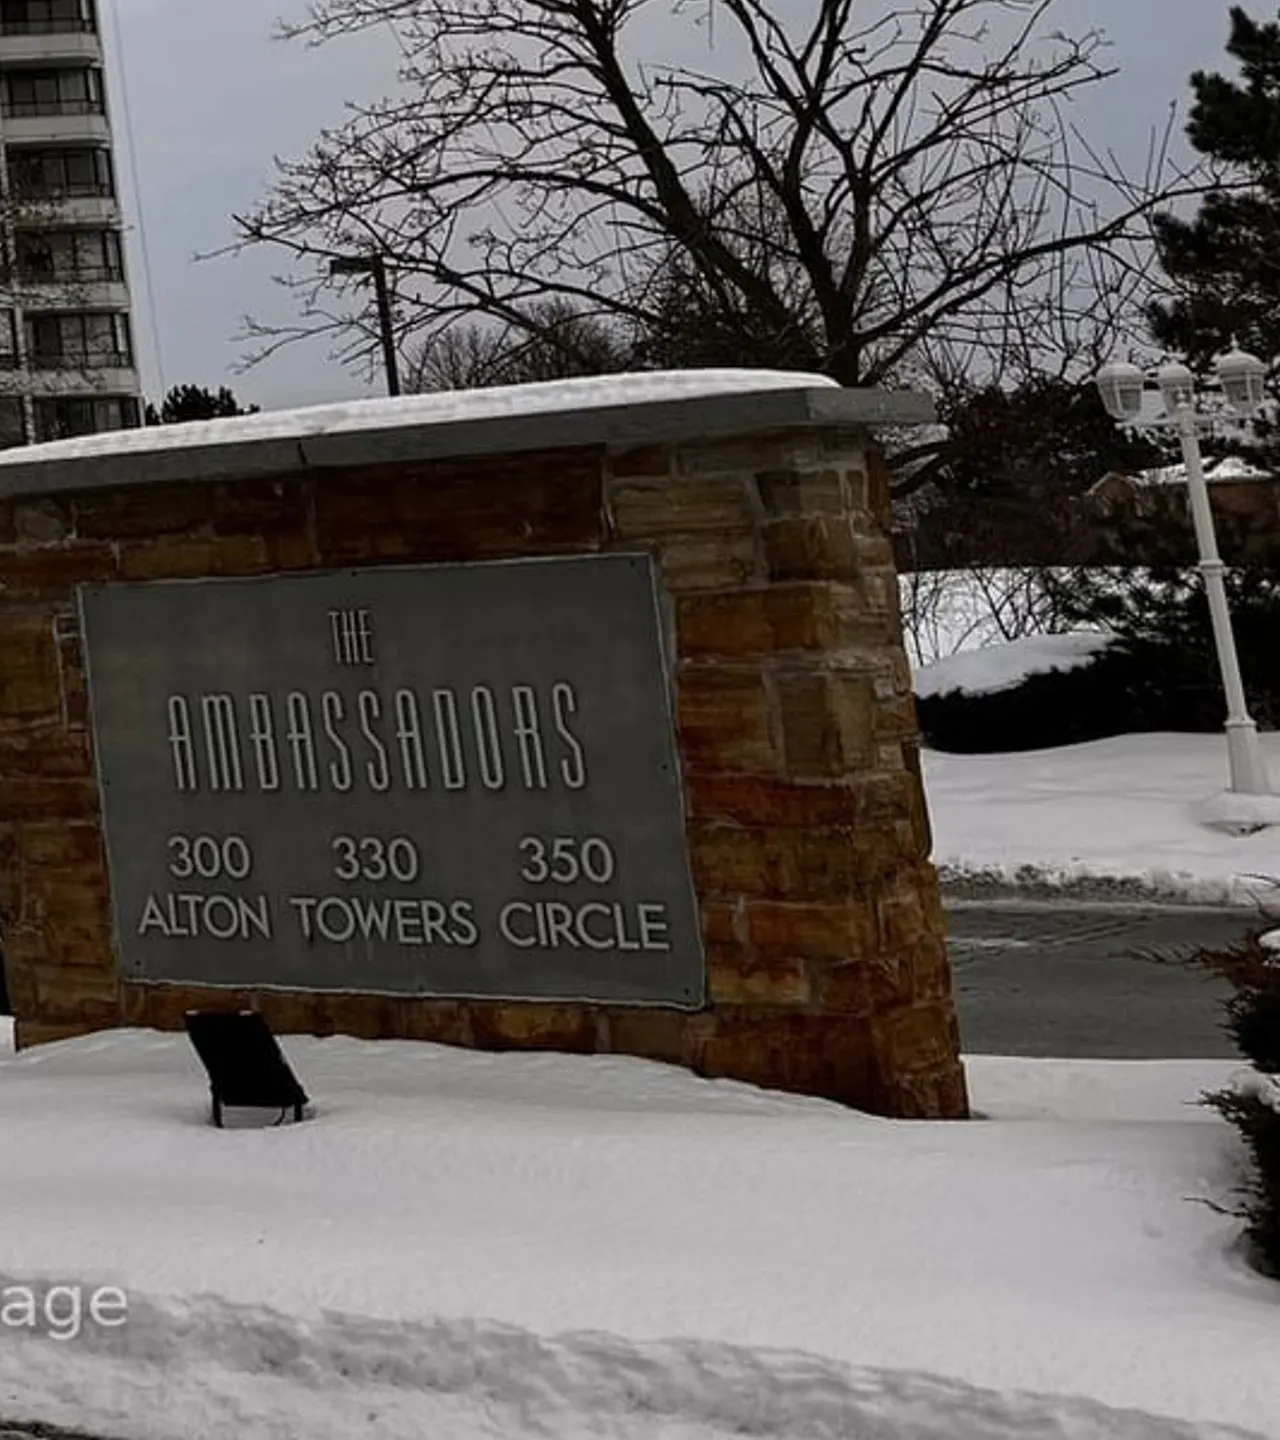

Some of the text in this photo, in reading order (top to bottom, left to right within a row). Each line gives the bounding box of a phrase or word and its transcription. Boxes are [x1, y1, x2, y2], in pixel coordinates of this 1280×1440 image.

[327, 609, 374, 665] THE
[167, 681, 587, 792] AMBASSADORS
[167, 835, 614, 884] 300 330 350
[139, 894, 670, 952] ALTON TOWERS CIRCLE
